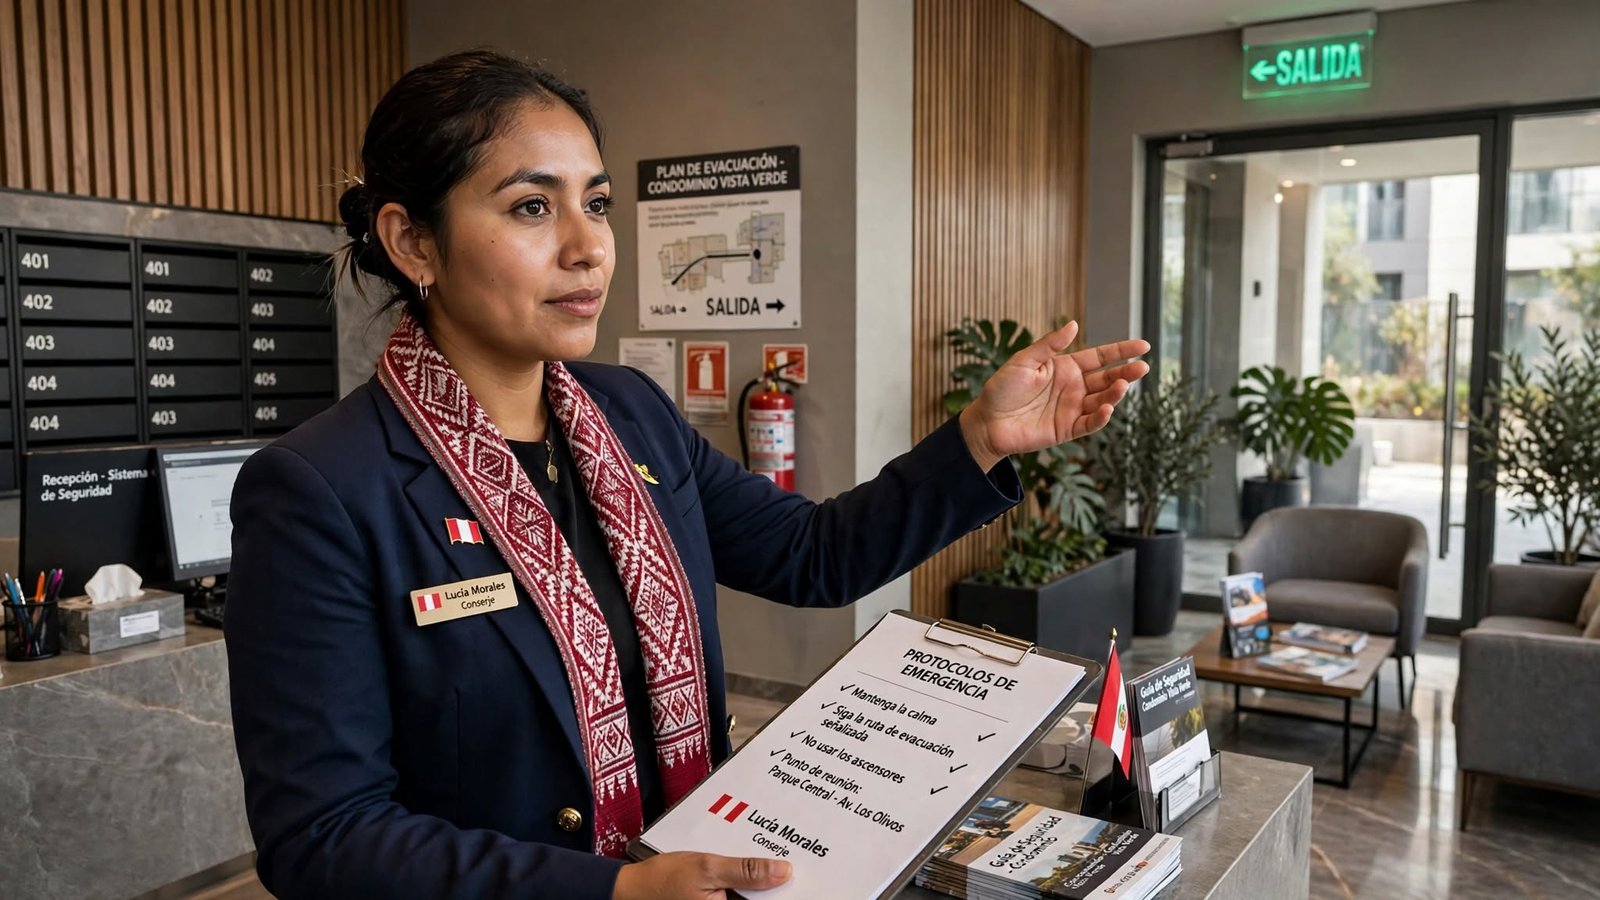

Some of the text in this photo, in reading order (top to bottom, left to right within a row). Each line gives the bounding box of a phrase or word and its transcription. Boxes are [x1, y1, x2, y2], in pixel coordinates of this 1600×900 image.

[1276, 42, 1362, 86] SALIDA
[656, 163, 685, 179] PLAN
[687, 162, 702, 177] DE
[704, 153, 778, 174] EVACUACIÓN
[647, 170, 788, 194] CONDOMINIO VISTA VERDE
[22, 253, 48, 268] 401
[145, 261, 169, 276] 401
[251, 268, 272, 282] 402
[23, 294, 52, 309] 402
[147, 299, 172, 313] 402
[252, 303, 273, 316] 403
[706, 297, 761, 316] SALIDA
[26, 335, 54, 350] 403
[149, 337, 174, 350] 403
[253, 338, 274, 351] 404
[28, 376, 57, 390] 404
[150, 374, 175, 387] 404
[255, 373, 276, 385] 405
[30, 415, 59, 430] 404
[152, 411, 176, 425] 403
[255, 407, 277, 420] 406
[42, 470, 98, 486] Recepción
[107, 468, 149, 481] Sistema
[41, 483, 112, 502] de Seguridad
[445, 583, 505, 599] Lucía Morales
[461, 596, 495, 609] Conserje
[903, 648, 1018, 691] PROTOCOLOS DE
[1154, 679, 1163, 692] de
[1162, 664, 1191, 687] Seguridad
[900, 664, 989, 700] EMERGENCIA
[851, 687, 938, 726] Mantenga la calma
[820, 718, 869, 742] señalizada
[832, 705, 954, 758] Siga la ruta de evacuación
[801, 734, 906, 784] No usar los ascensores
[781, 752, 862, 794] Punto de reunión:
[768, 764, 800, 786] Parque
[800, 779, 836, 800] Central
[836, 796, 852, 811] Av.
[854, 803, 873, 818] Los
[872, 811, 905, 833] Olivos
[747, 809, 829, 858] Lucía Morales
[1008, 845, 1026, 853] de
[1018, 815, 1062, 846] Seguridad
[752, 832, 790, 857] Conserje
